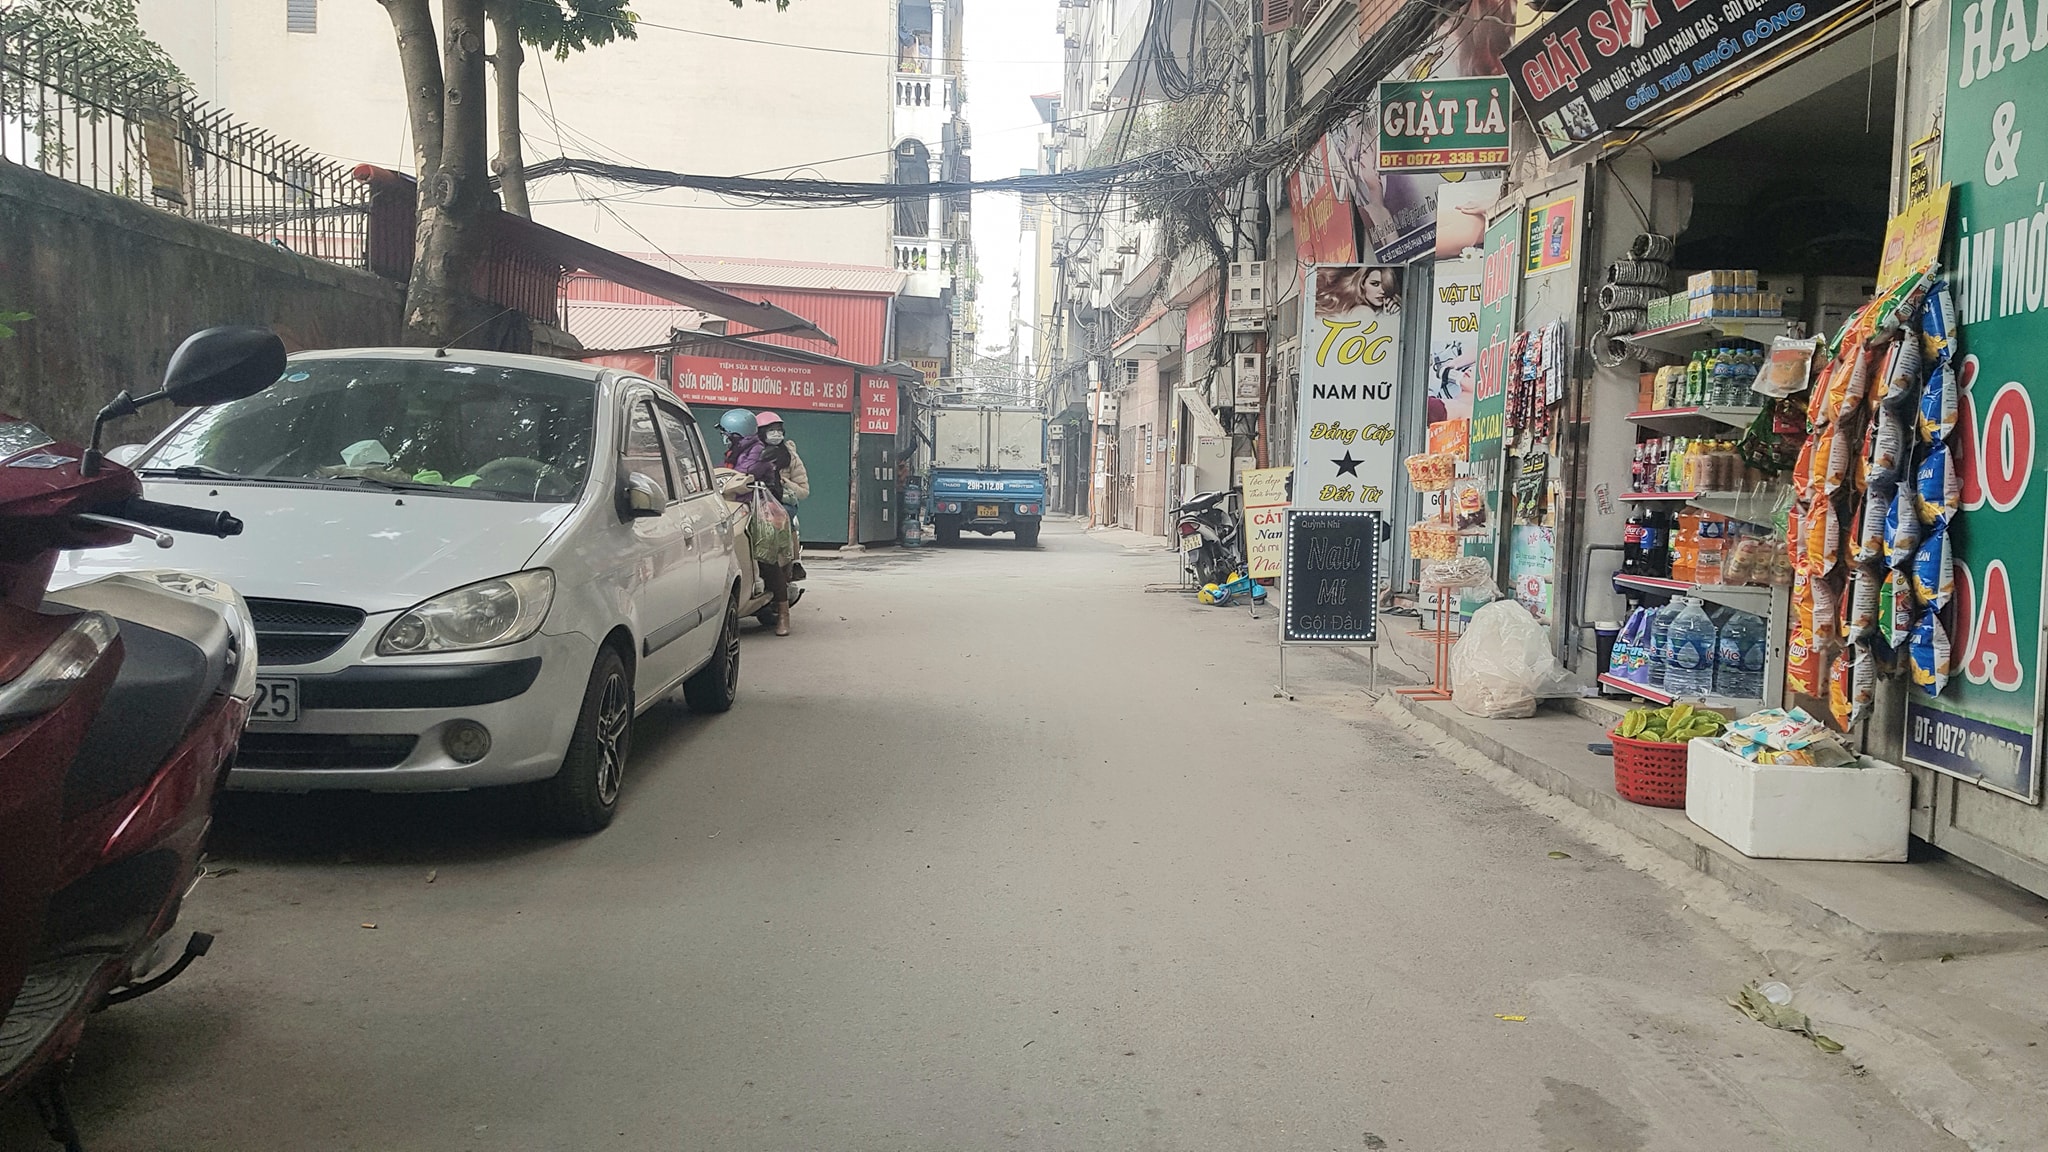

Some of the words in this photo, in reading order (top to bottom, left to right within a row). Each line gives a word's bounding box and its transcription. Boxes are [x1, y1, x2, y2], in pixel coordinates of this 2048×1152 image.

[1630, 55, 1651, 78] CÁC
[1648, 42, 1673, 66] LOẠI
[1669, 27, 1698, 56] CHĂN
[1694, 14, 1719, 40] GAS
[1692, 37, 1741, 75] NHỒI
[1742, 3, 1805, 47] BÔNG
[1522, 27, 1592, 101] GIẶT
[1383, 89, 1459, 144] GIẶT
[1465, 87, 1506, 134] LÀ
[1381, 154, 1403, 166] ĐT:
[1479, 150, 1505, 163] 587
[1984, 101, 2022, 186] &
[2000, 181, 2048, 319] MỚ
[1483, 233, 1516, 313] GIẶT
[1439, 283, 1468, 305] VẬT
[1316, 317, 1393, 367] Tóc
[720, 362, 734, 370] TIỆM
[1476, 323, 1507, 402] SẤY
[679, 368, 697, 390] SỬA
[700, 372, 724, 392] CHỮA
[732, 372, 750, 392] BẢO
[752, 376, 782, 395] DƯỠNG
[790, 381, 801, 396] XE
[804, 382, 814, 397] GA
[823, 383, 834, 398] XE
[836, 379, 848, 399] SỐ
[868, 378, 890, 389] RỬA
[872, 394, 886, 402] XE
[1312, 384, 1356, 400] NAM
[1362, 381, 1392, 400] NỮ
[866, 407, 892, 416] THAY
[1310, 421, 1358, 446] Đẳng
[1361, 422, 1396, 446] Cấp
[1319, 484, 1354, 503] Đến
[1307, 536, 1361, 570] Nail
[1318, 578, 1346, 605] Mi
[1300, 614, 1326, 633] Gội
[1330, 610, 1362, 630] Đầu
[251, 683, 290, 717] 25
[1915, 716, 1934, 747] ĐT:
[1936, 722, 1966, 758] 0972
